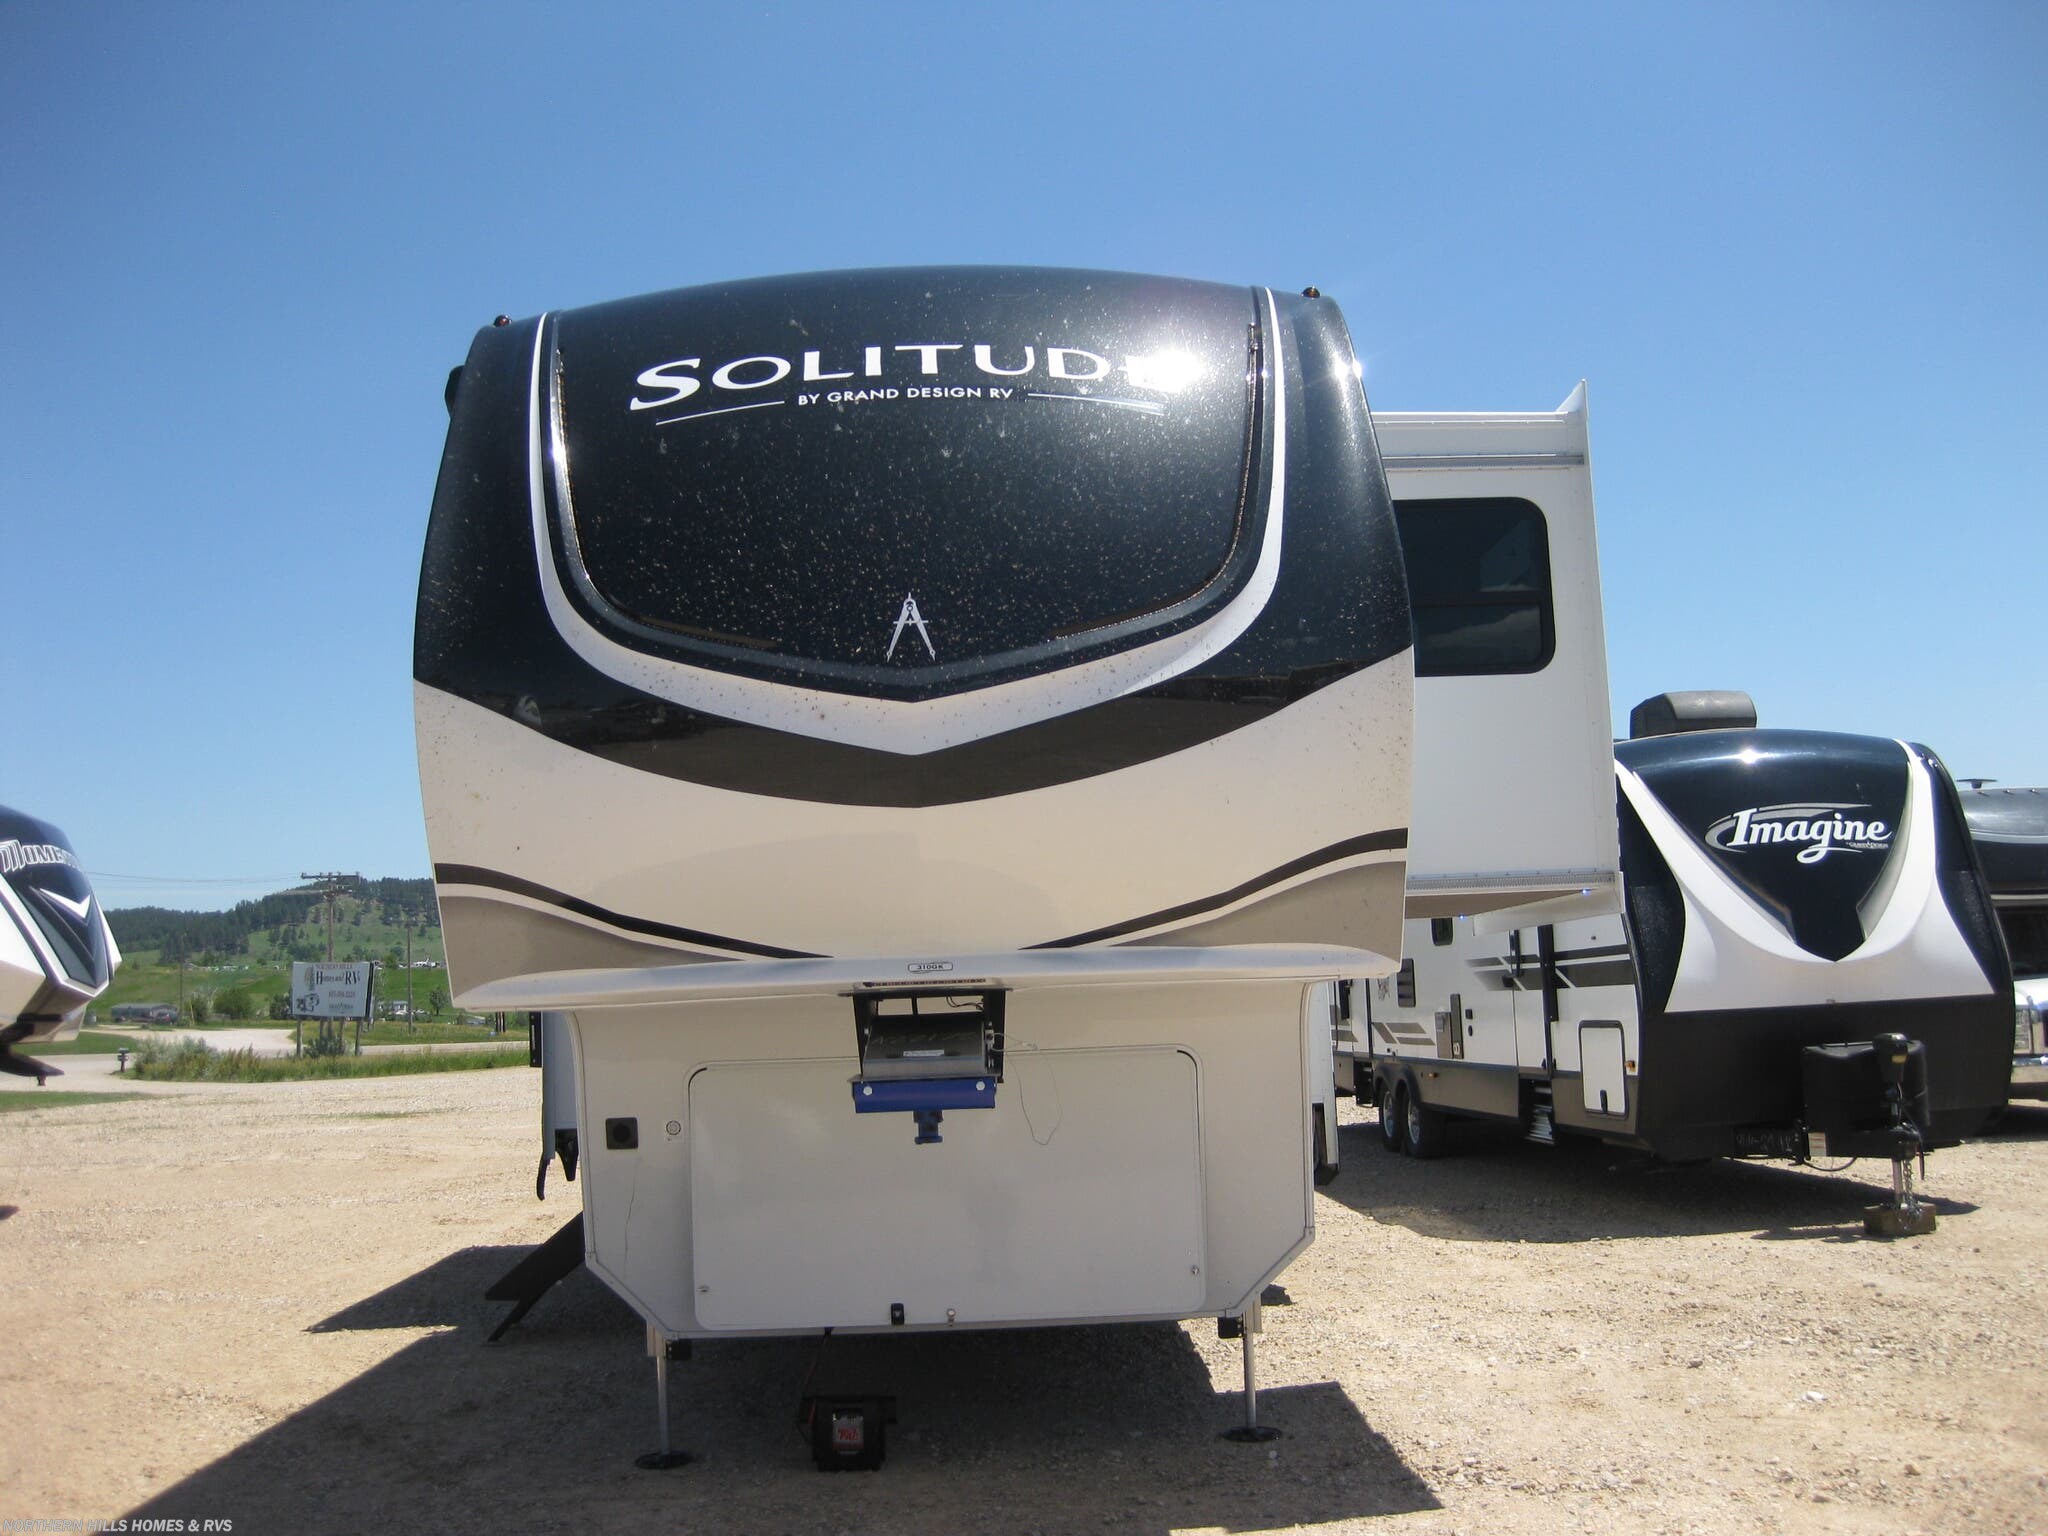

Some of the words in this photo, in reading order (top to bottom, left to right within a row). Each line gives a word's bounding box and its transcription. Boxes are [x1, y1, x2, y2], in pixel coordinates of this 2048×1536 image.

[798, 394, 820, 406] BY
[827, 388, 900, 403] GRAND
[907, 386, 982, 399] DESIGN
[989, 388, 1014, 400] RV
[1726, 807, 1893, 864] Imagine
